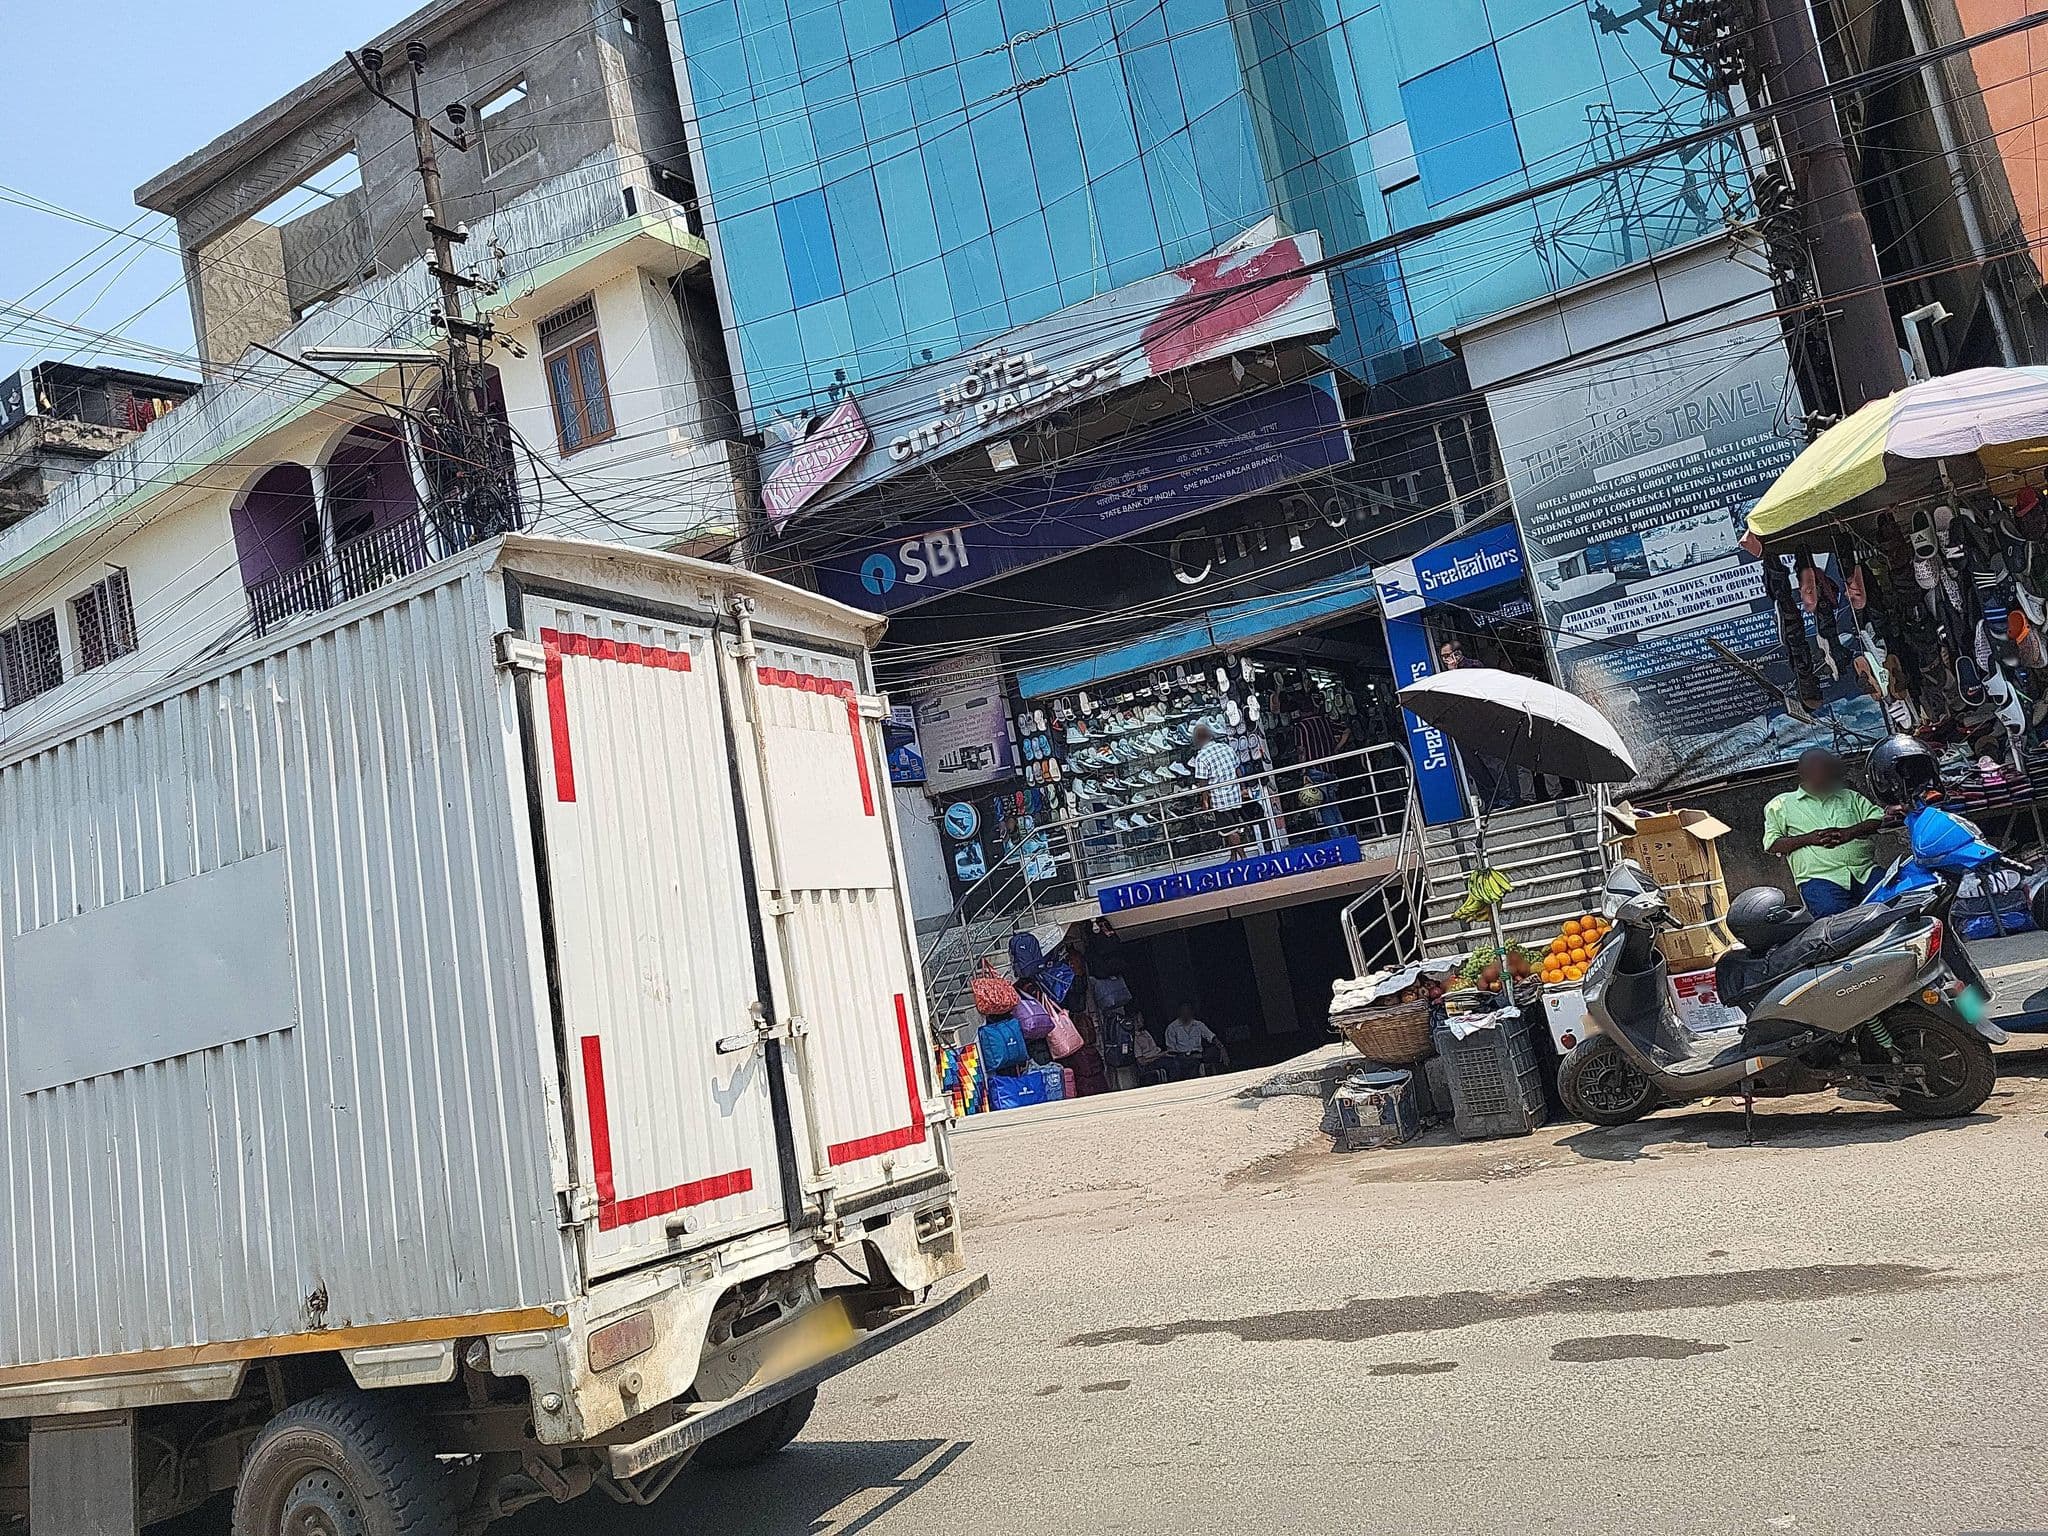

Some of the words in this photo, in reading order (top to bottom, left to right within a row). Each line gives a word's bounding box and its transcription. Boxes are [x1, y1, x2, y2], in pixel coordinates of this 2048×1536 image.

[936, 351, 1050, 412] HOTEL
[888, 411, 966, 462] CITY
[974, 358, 1121, 424] PALACE
[766, 412, 869, 511] KINGFISHER
[1183, 479, 1199, 492] SME
[1199, 470, 1227, 487] PALTAN
[1226, 463, 1251, 478] BAZAR
[1251, 452, 1284, 469] BRANCH
[1519, 441, 1576, 487] THE
[1576, 415, 1664, 469] MINES
[1536, 494, 1568, 511] HOTELS
[1569, 482, 1608, 501] BOOKING
[1614, 472, 1637, 487] CABS
[1638, 460, 1678, 479] BOOKING
[1685, 453, 1701, 464] AIR
[1702, 442, 1735, 459] TICKET
[1741, 430, 1774, 447] CRUISE
[1100, 507, 1122, 521] STATE
[1122, 500, 1143, 513] BANK
[1143, 496, 1154, 506] OF
[1155, 488, 1177, 502] INDIA
[1530, 512, 1550, 525] VISA
[1555, 500, 1591, 518] HOLIDAY
[1592, 486, 1636, 506] PACKAGES
[1642, 474, 1673, 490] GROUP
[1675, 465, 1705, 480] TOURS
[1711, 448, 1758, 470] INCENTIVE
[1759, 439, 1791, 455] TOURS
[1531, 517, 1573, 537] STUDENTS
[1574, 508, 1604, 524] GROUP
[1609, 489, 1666, 513] CONFERENCE
[1671, 474, 1716, 495] MEETINGS
[1722, 463, 1755, 480] SOCIAL
[1756, 452, 1791, 469] EVENTS
[1541, 525, 1590, 546] CORPORATE
[1591, 515, 1623, 531] EVENTS
[1629, 499, 1673, 520] BIRTHDAY
[1674, 491, 1703, 507] PARTY
[1709, 475, 1758, 496] BACHELOR
[1586, 525, 1631, 545] MARRIAGE
[1631, 516, 1659, 532] PARTY
[1665, 507, 1691, 522] KITTY
[1692, 498, 1721, 514] PARTY
[1725, 491, 1752, 504] ETC...
[899, 527, 969, 584] SBI
[1421, 548, 1519, 591] Sreeleathers
[1566, 606, 1606, 624] THAILAND
[1613, 591, 1661, 611] INDONESIA,
[1662, 581, 1707, 598] MALDIVES,
[1709, 564, 1760, 584] CAMBODIA,
[1567, 616, 1611, 634] MALAYSIA,
[1611, 606, 1651, 623] VIETNAM,
[1653, 598, 1678, 611] LAOS,
[1681, 586, 1726, 604] MYANMER
[1606, 619, 1644, 635] BHUTAN,
[1645, 610, 1676, 625] NEPAL,
[1676, 600, 1715, 619] EUROPE,
[1715, 591, 1748, 610] DUBAI,
[1733, 612, 1773, 627] TAWANG,
[1695, 629, 1736, 646] TRNGLE
[1612, 660, 1646, 675] MANALI,
[1636, 667, 1653, 677] AND
[1117, 873, 1199, 909] HOTEL
[1200, 865, 1251, 889] CITY
[1256, 845, 1344, 878] PALACE
[1835, 975, 1880, 997] Optima
